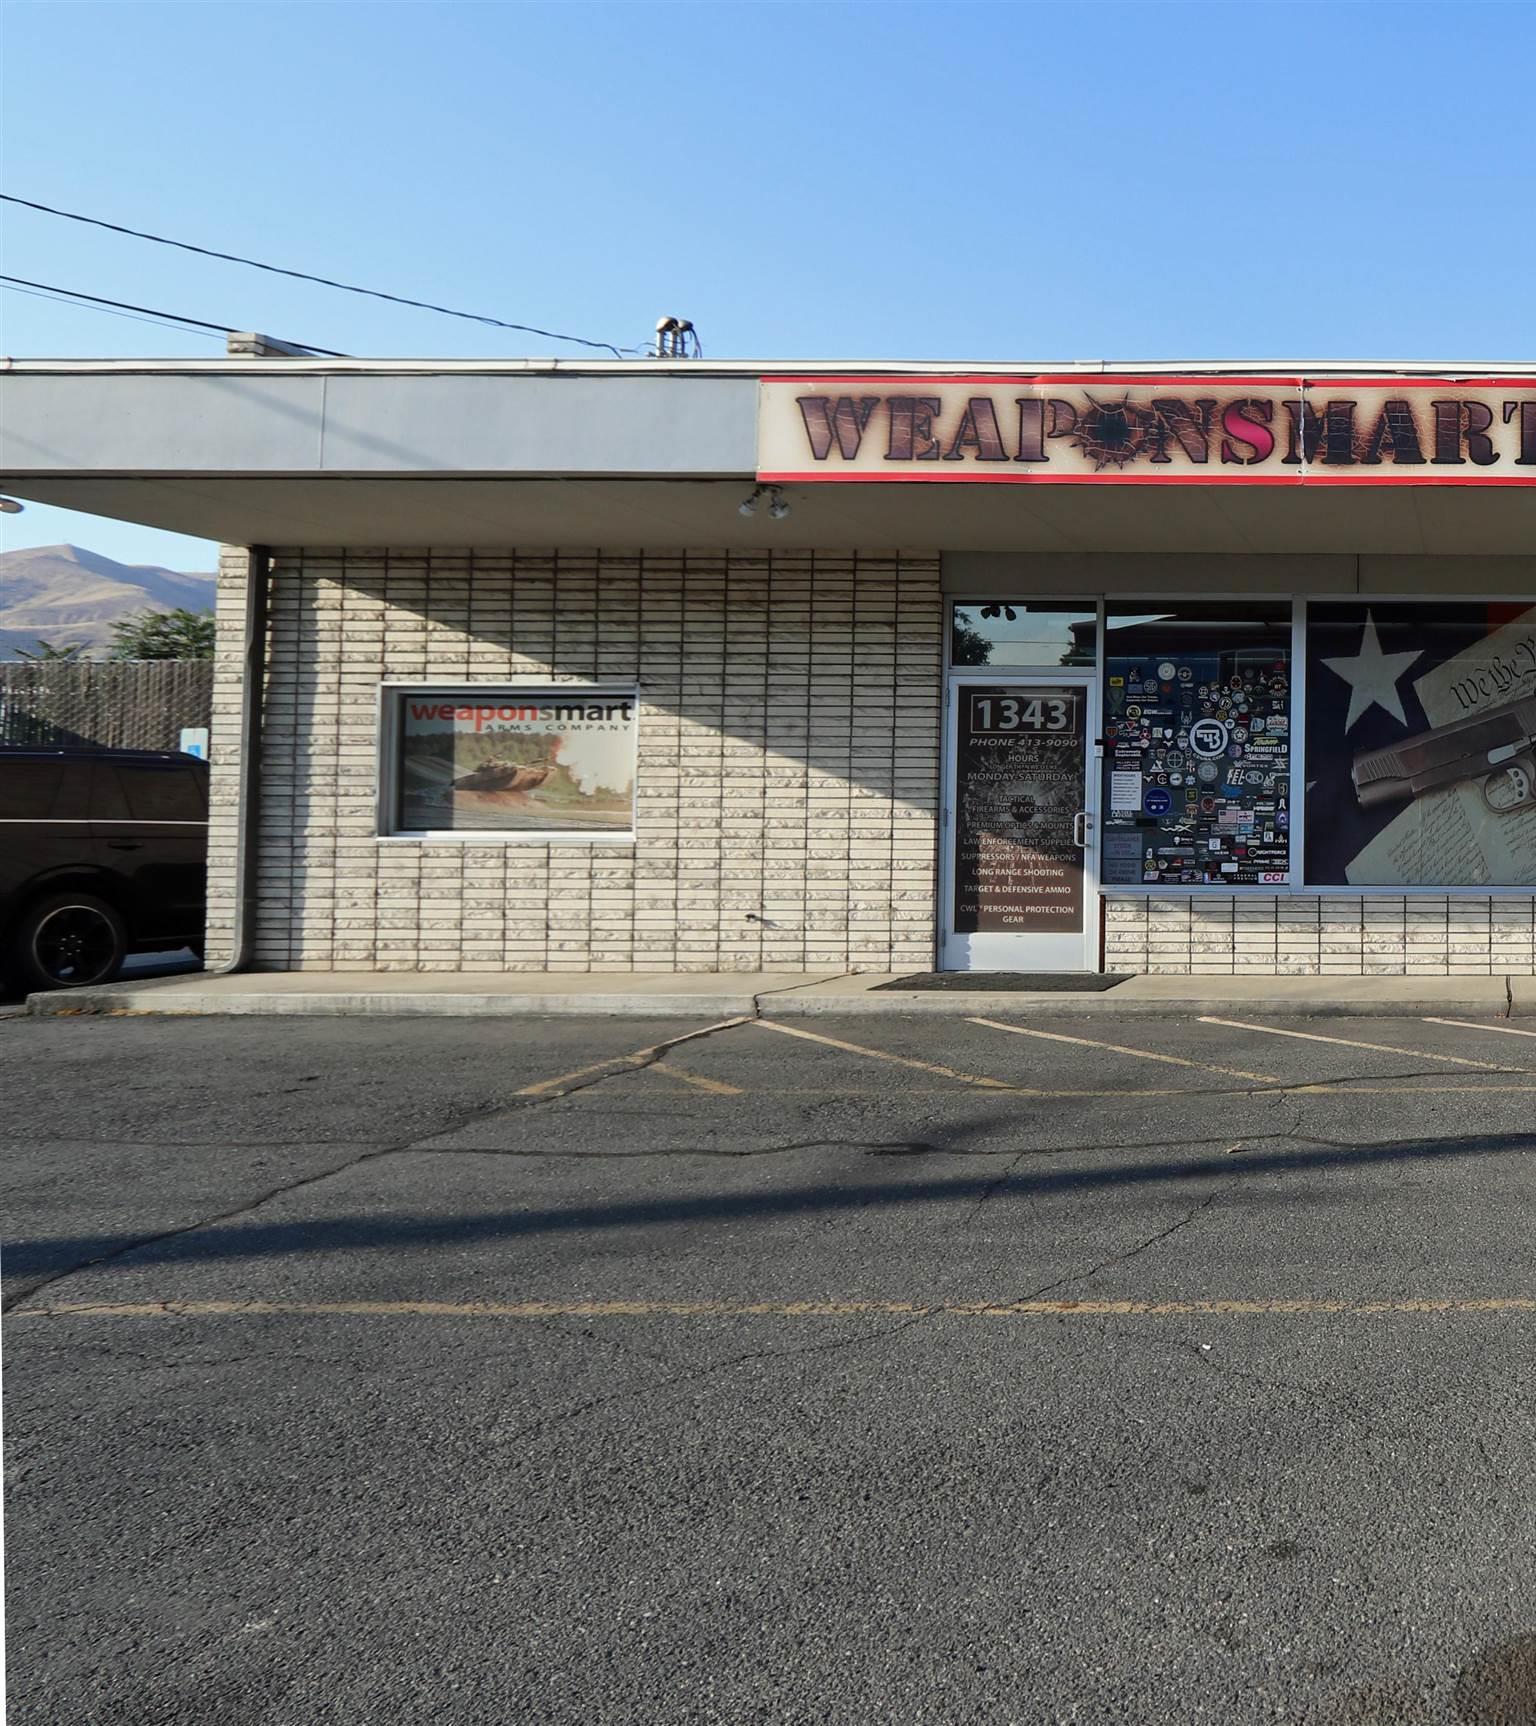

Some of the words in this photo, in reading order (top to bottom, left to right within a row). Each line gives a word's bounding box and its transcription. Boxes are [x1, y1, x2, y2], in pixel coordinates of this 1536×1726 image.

[1451, 668, 1491, 709] We
[1488, 656, 1521, 693] the
[411, 701, 631, 732] weaponsmart
[977, 699, 1067, 730] 1343
[486, 723, 533, 732] ARMS
[546, 724, 631, 732] COMPANY
[969, 738, 1016, 747] PHONE
[1017, 738, 1078, 747] 413-9090
[1019, 806, 1070, 814] ACCESSORIES
[961, 853, 1015, 861] SUPPRESSORS
[1037, 854, 1076, 862] WEAPONS
[1023, 869, 1064, 877] SHOOTING
[1263, 873, 1285, 882] CCI
[1025, 906, 1074, 914] PROTECTION
